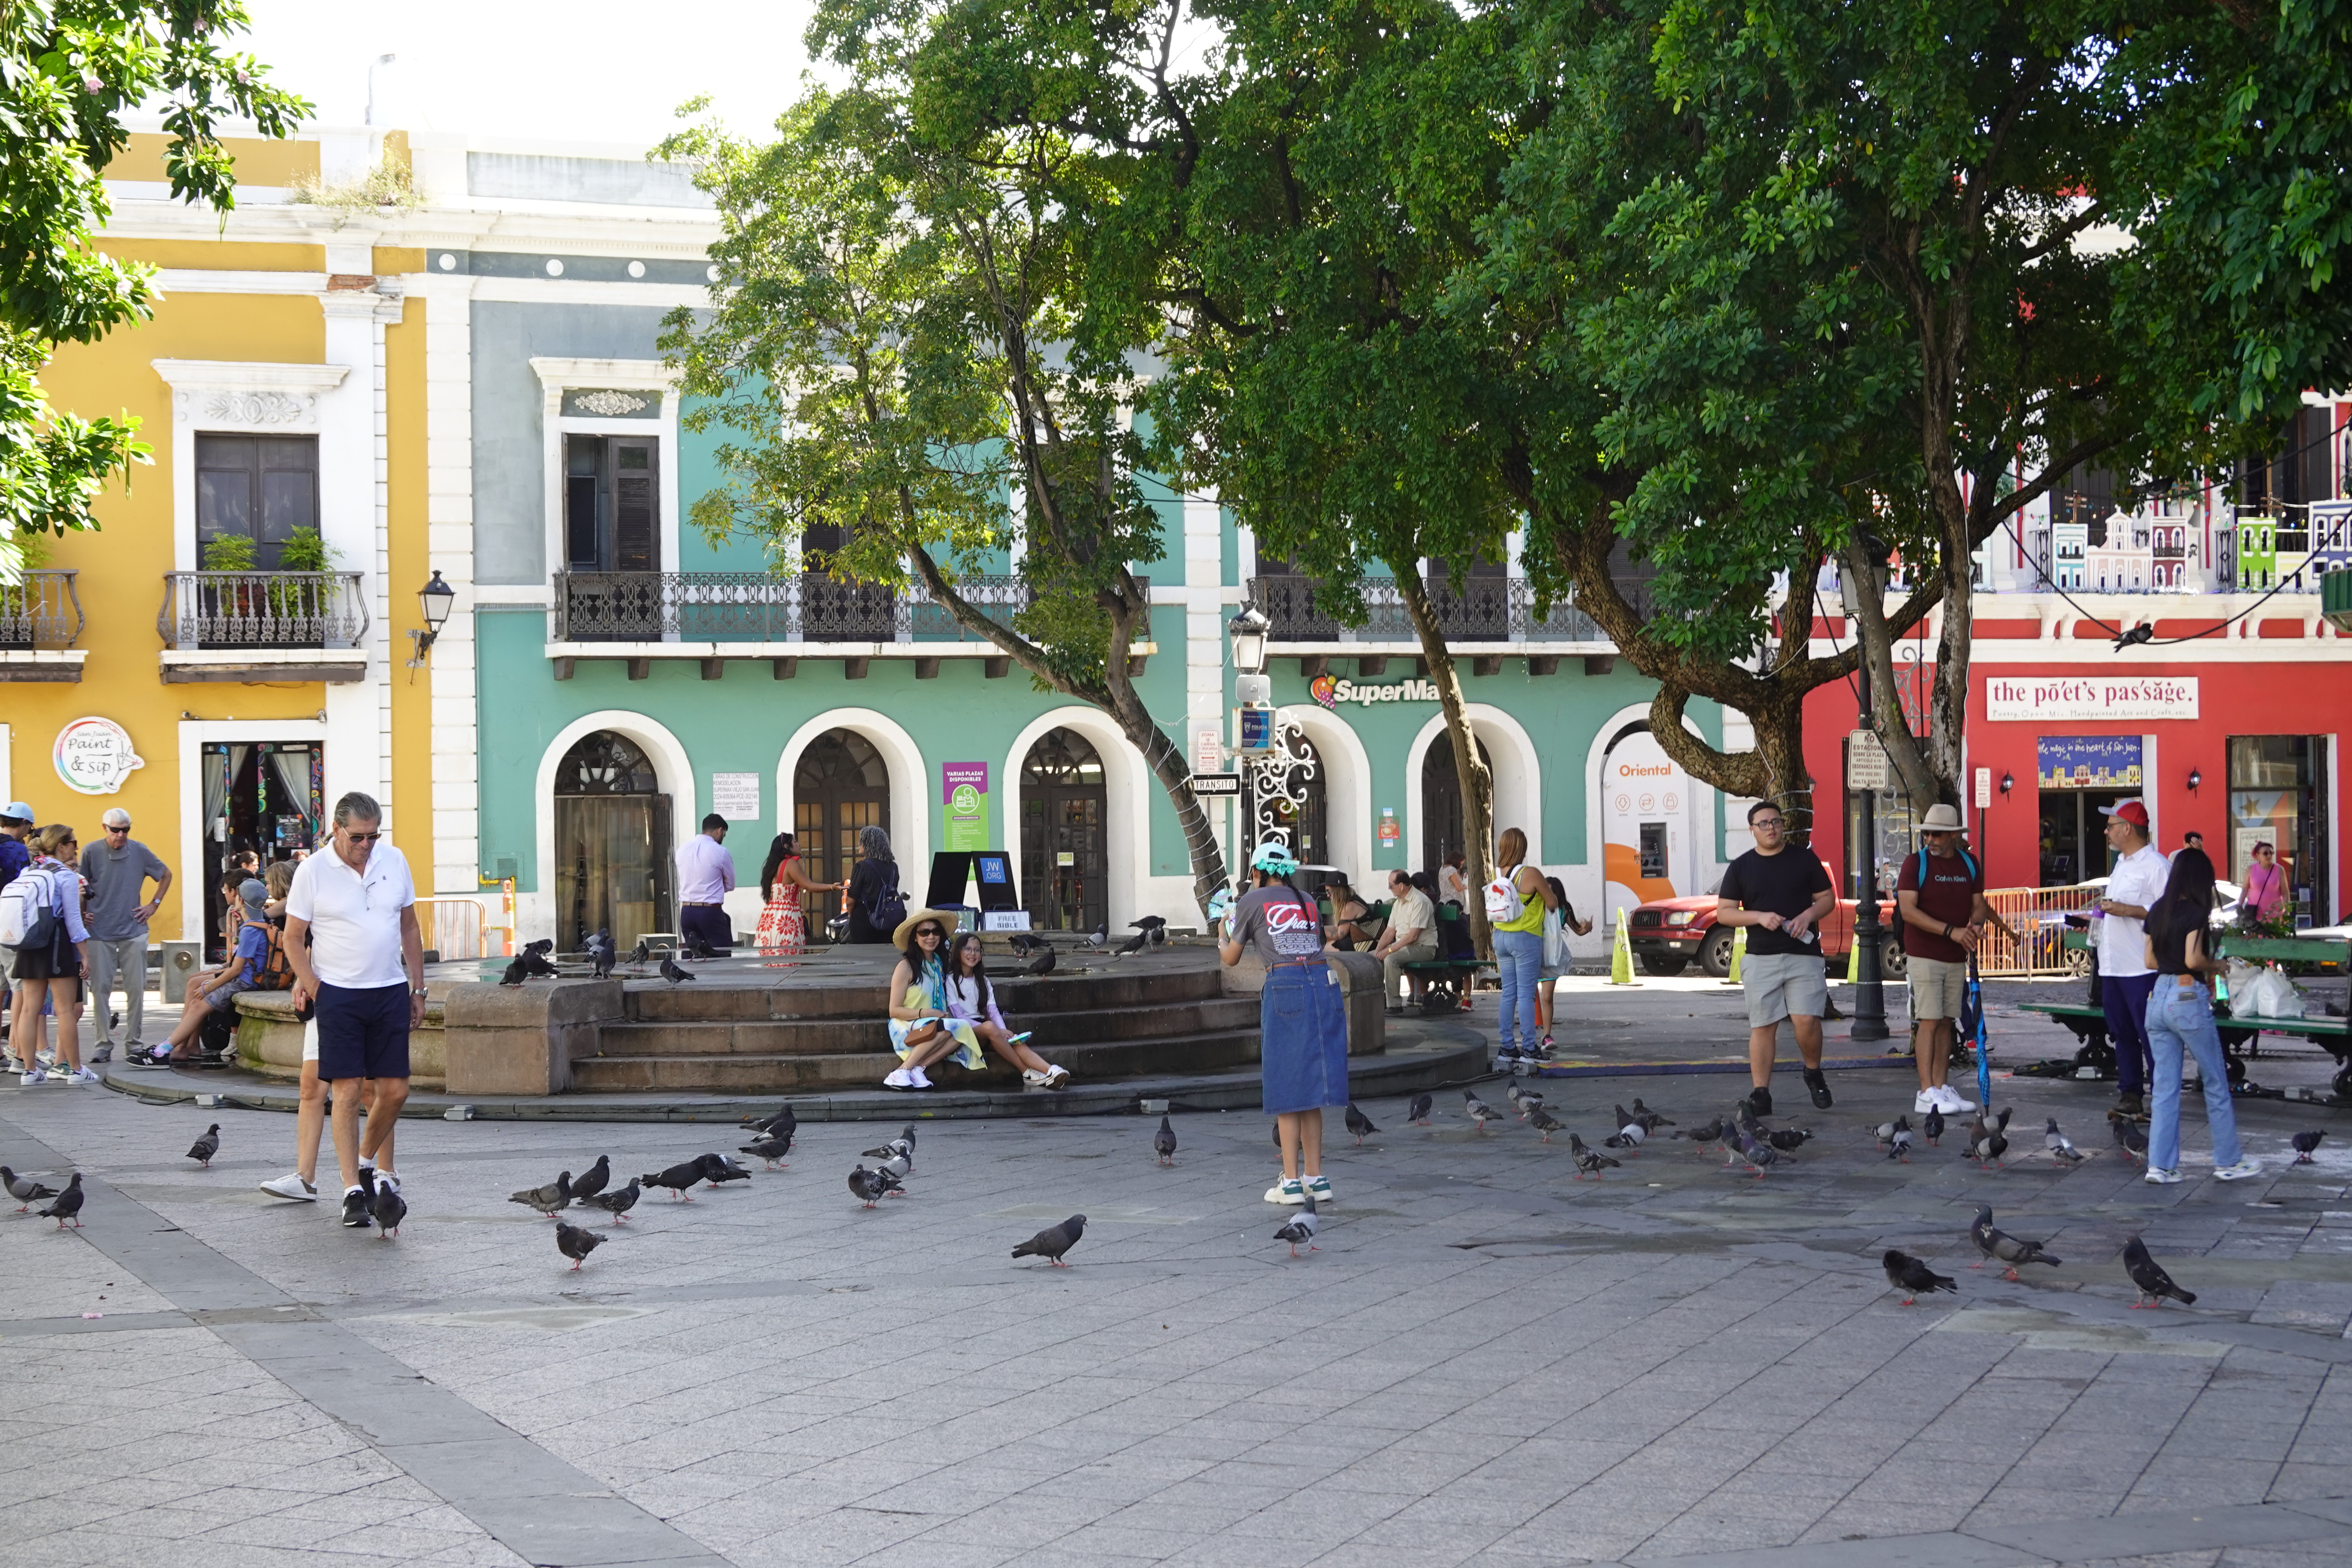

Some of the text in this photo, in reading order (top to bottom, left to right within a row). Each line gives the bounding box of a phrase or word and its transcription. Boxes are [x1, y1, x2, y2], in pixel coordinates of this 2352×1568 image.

[1333, 679, 1440, 706] SuperMa
[1994, 681, 2026, 701] the
[2021, 709, 2044, 718] Open
[2070, 709, 2117, 719] Handpainted
[68, 738, 113, 749] Paint
[2050, 744, 2066, 757] magic
[2067, 743, 2073, 751] in
[2074, 743, 2085, 751] the
[2086, 741, 2105, 753] heart
[2106, 741, 2113, 754] of
[2113, 741, 2124, 751] San
[71, 756, 85, 771] &
[1619, 763, 1671, 777] Oriental
[1195, 780, 1234, 790] TRANSITO
[986, 861, 999, 872] JW
